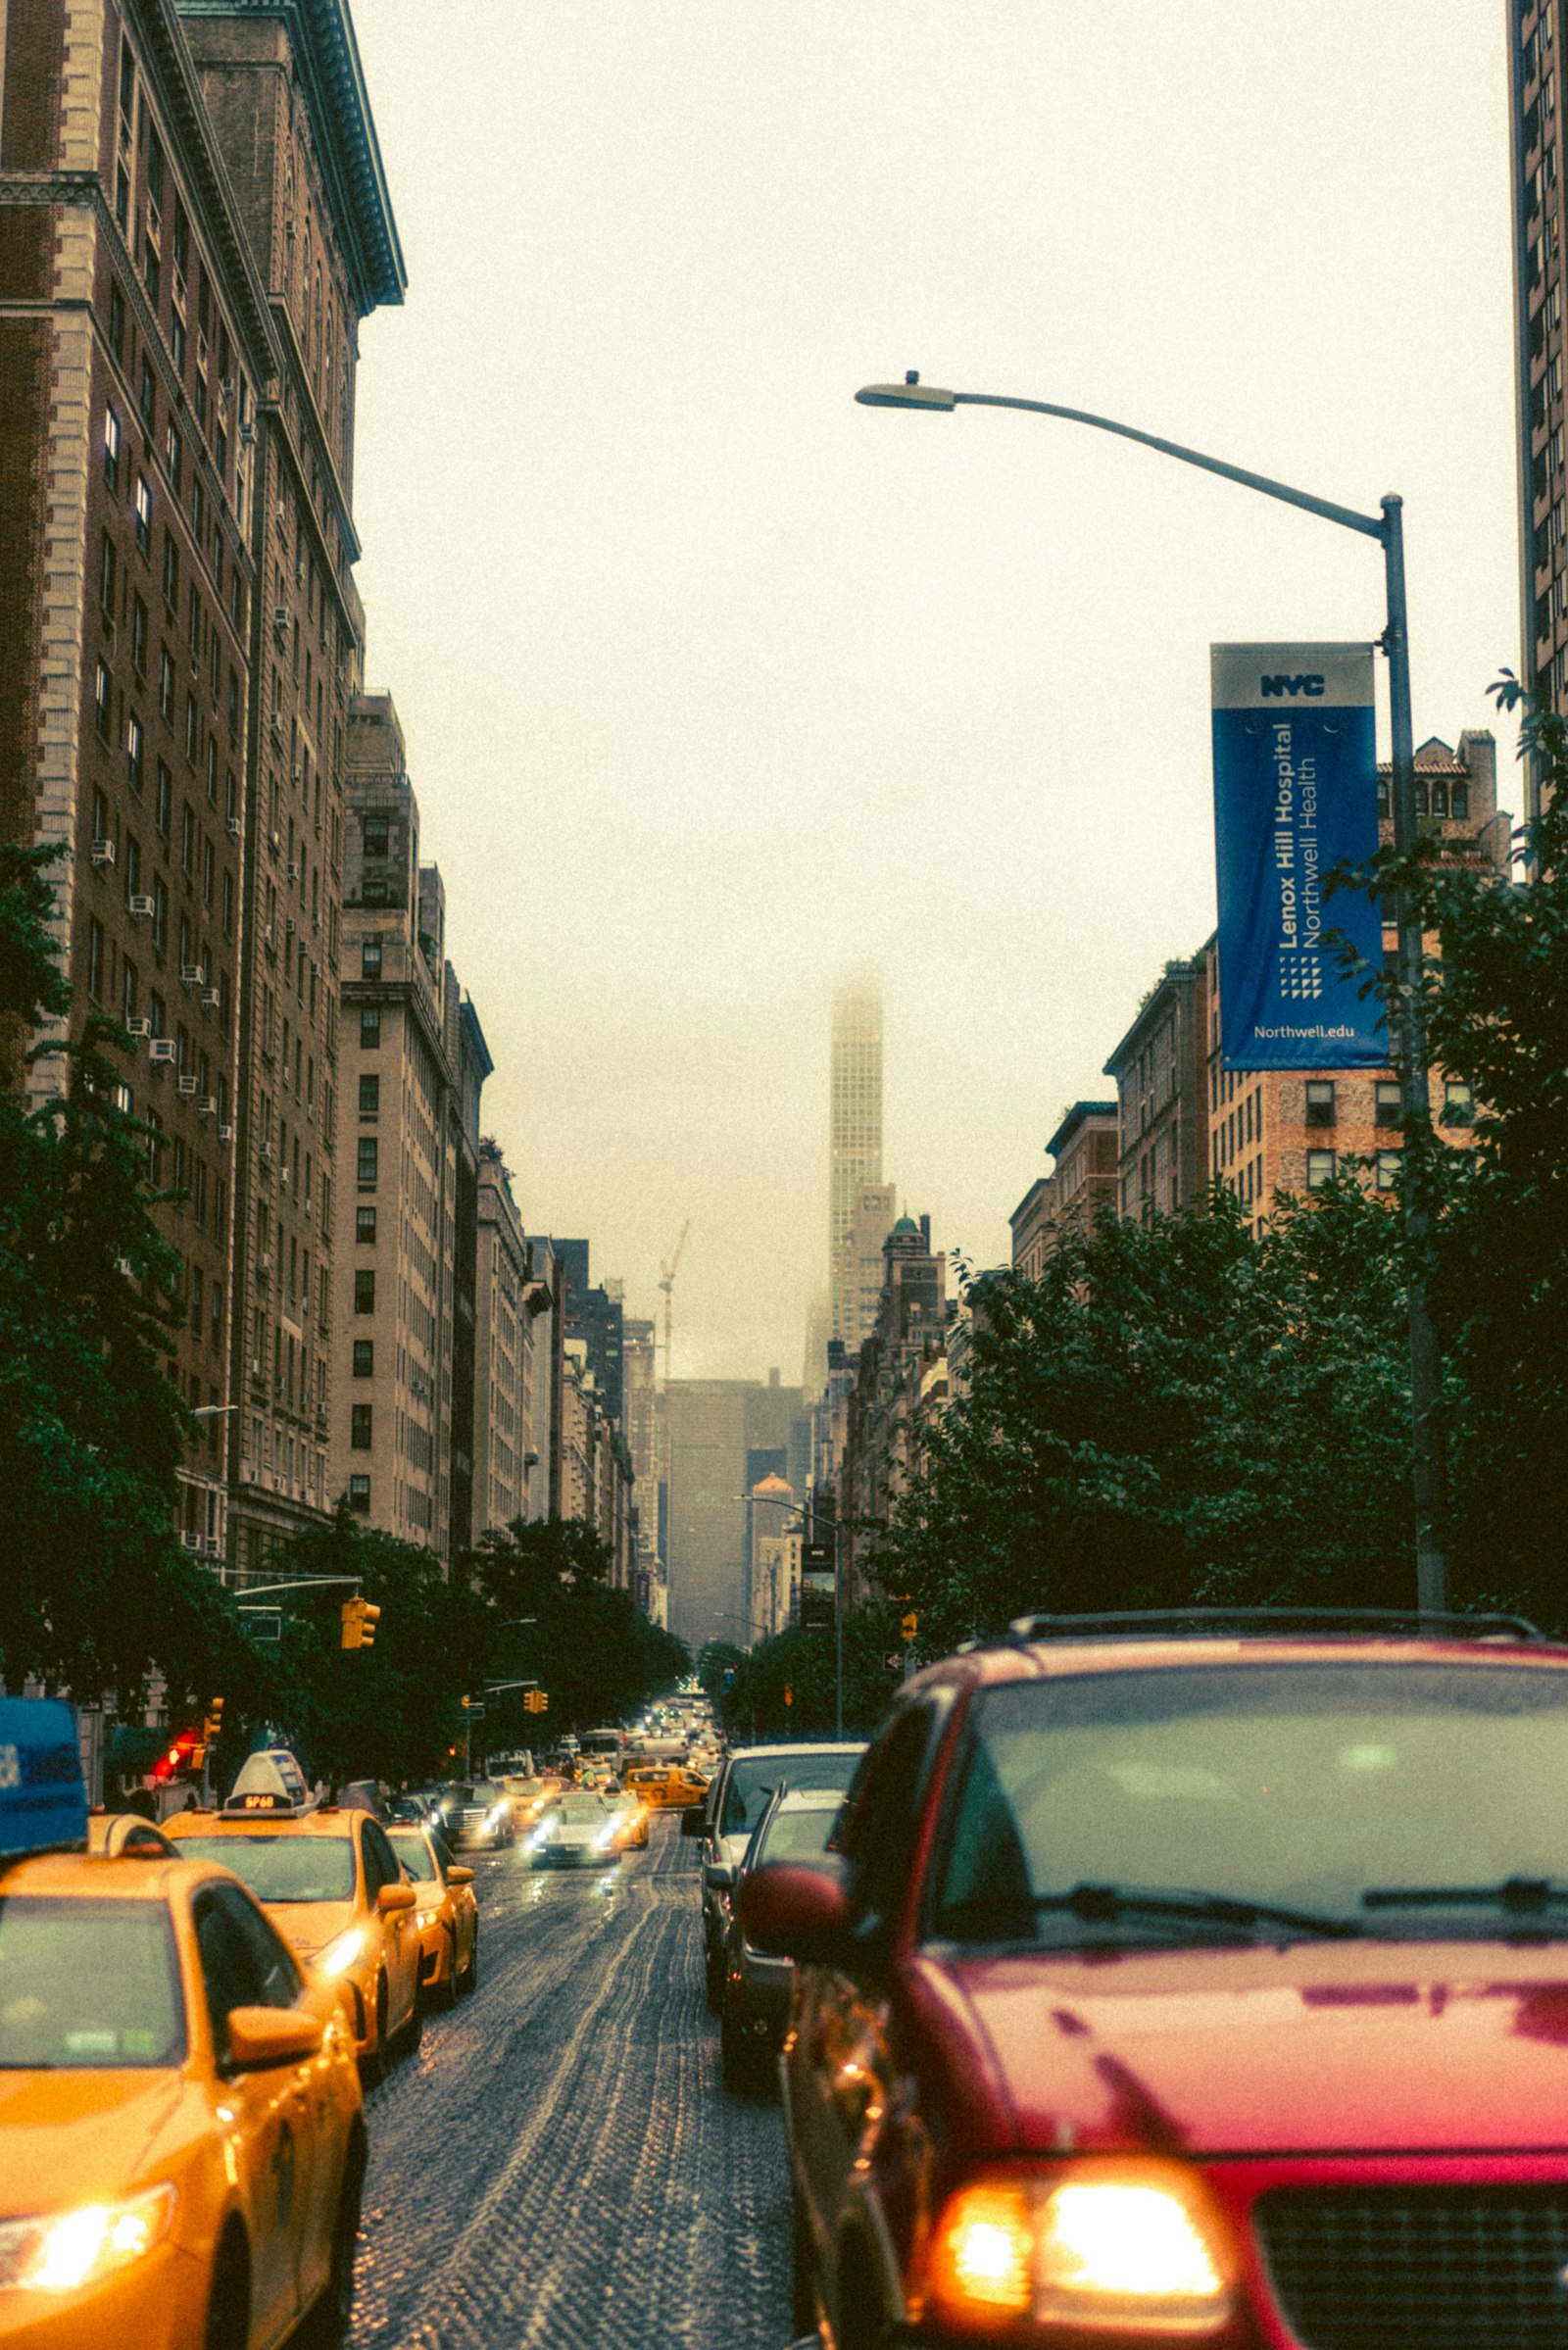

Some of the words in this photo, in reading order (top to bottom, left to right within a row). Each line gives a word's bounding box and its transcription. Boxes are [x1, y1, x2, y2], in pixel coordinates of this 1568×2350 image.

[1260, 674, 1325, 698] NYC
[1272, 723, 1296, 822] Hospital
[1297, 758, 1317, 829] Health
[1275, 831, 1295, 869] Hill
[1278, 877, 1298, 949] Lenox
[1298, 837, 1321, 949] Northwell
[1253, 1024, 1355, 1039] Northwell.edu
